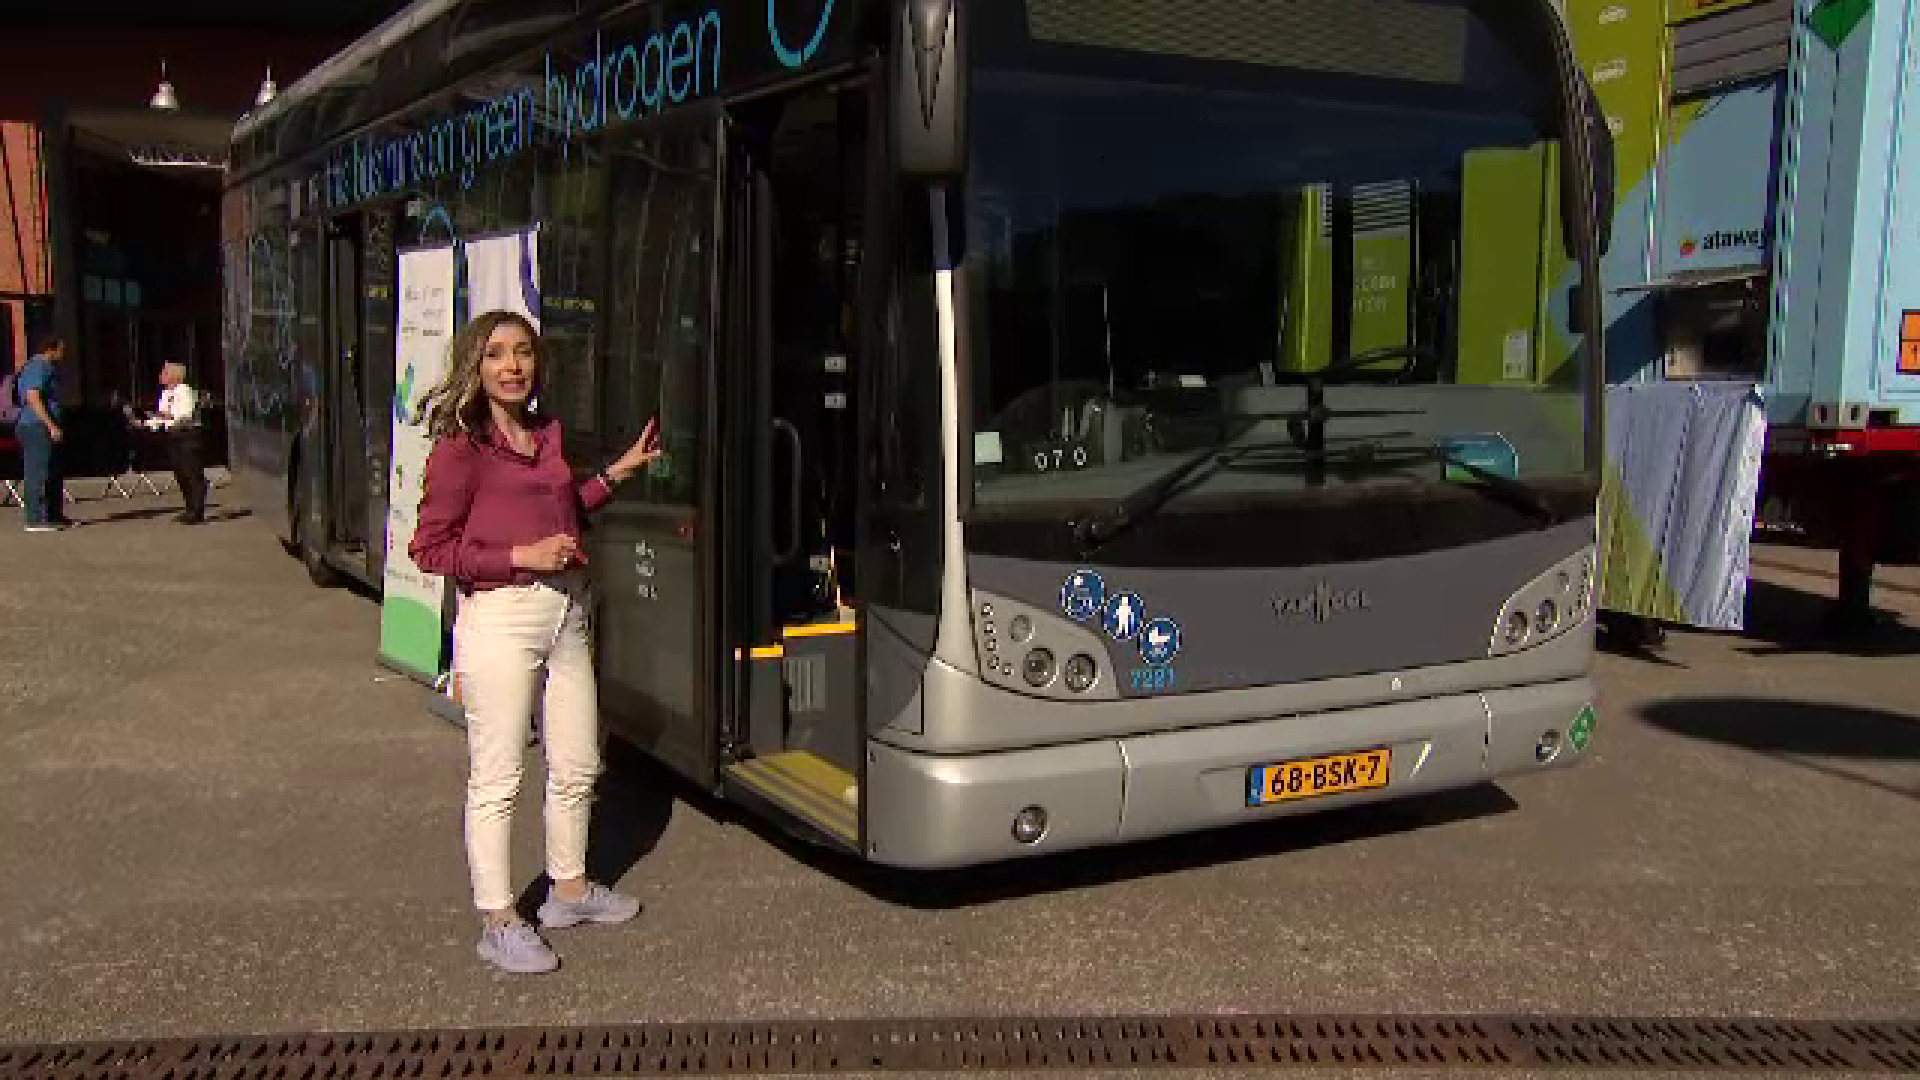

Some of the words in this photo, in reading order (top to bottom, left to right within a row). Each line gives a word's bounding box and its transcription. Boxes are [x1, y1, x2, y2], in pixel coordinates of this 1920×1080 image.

[459, 86, 536, 191] green
[544, 9, 721, 161] hydrogen
[1271, 755, 1381, 796] 68-BSK-7
